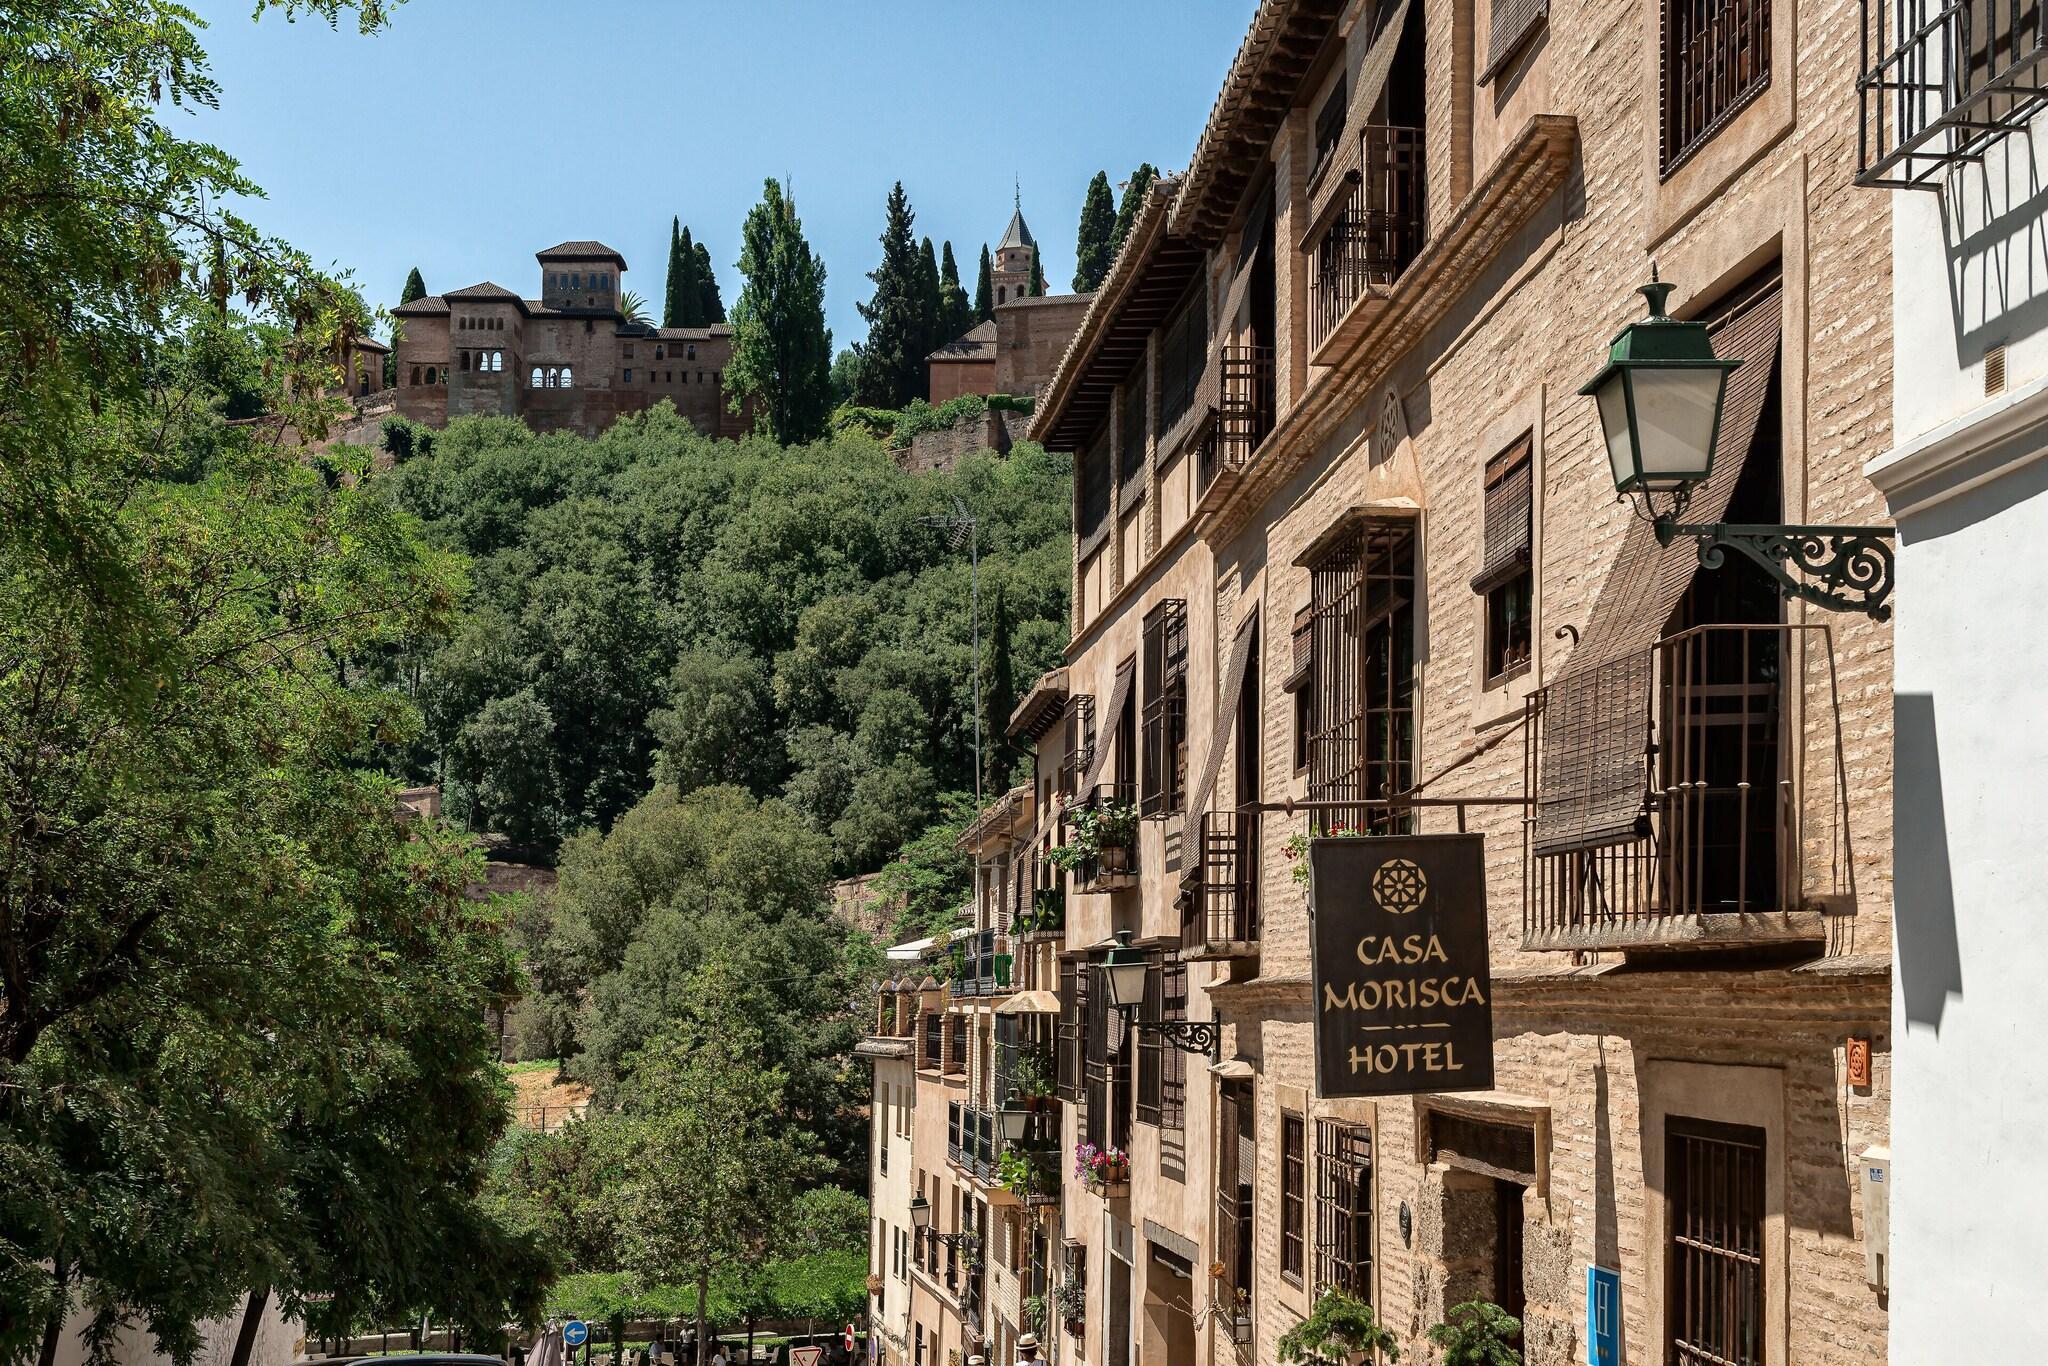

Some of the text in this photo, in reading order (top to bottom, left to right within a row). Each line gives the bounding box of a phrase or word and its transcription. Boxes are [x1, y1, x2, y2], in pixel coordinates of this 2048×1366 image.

[1357, 934, 1448, 965] CASA
[1324, 976, 1486, 1012] MORISCA
[1348, 1041, 1464, 1075] HOTEL
[1596, 1280, 1610, 1338] H
